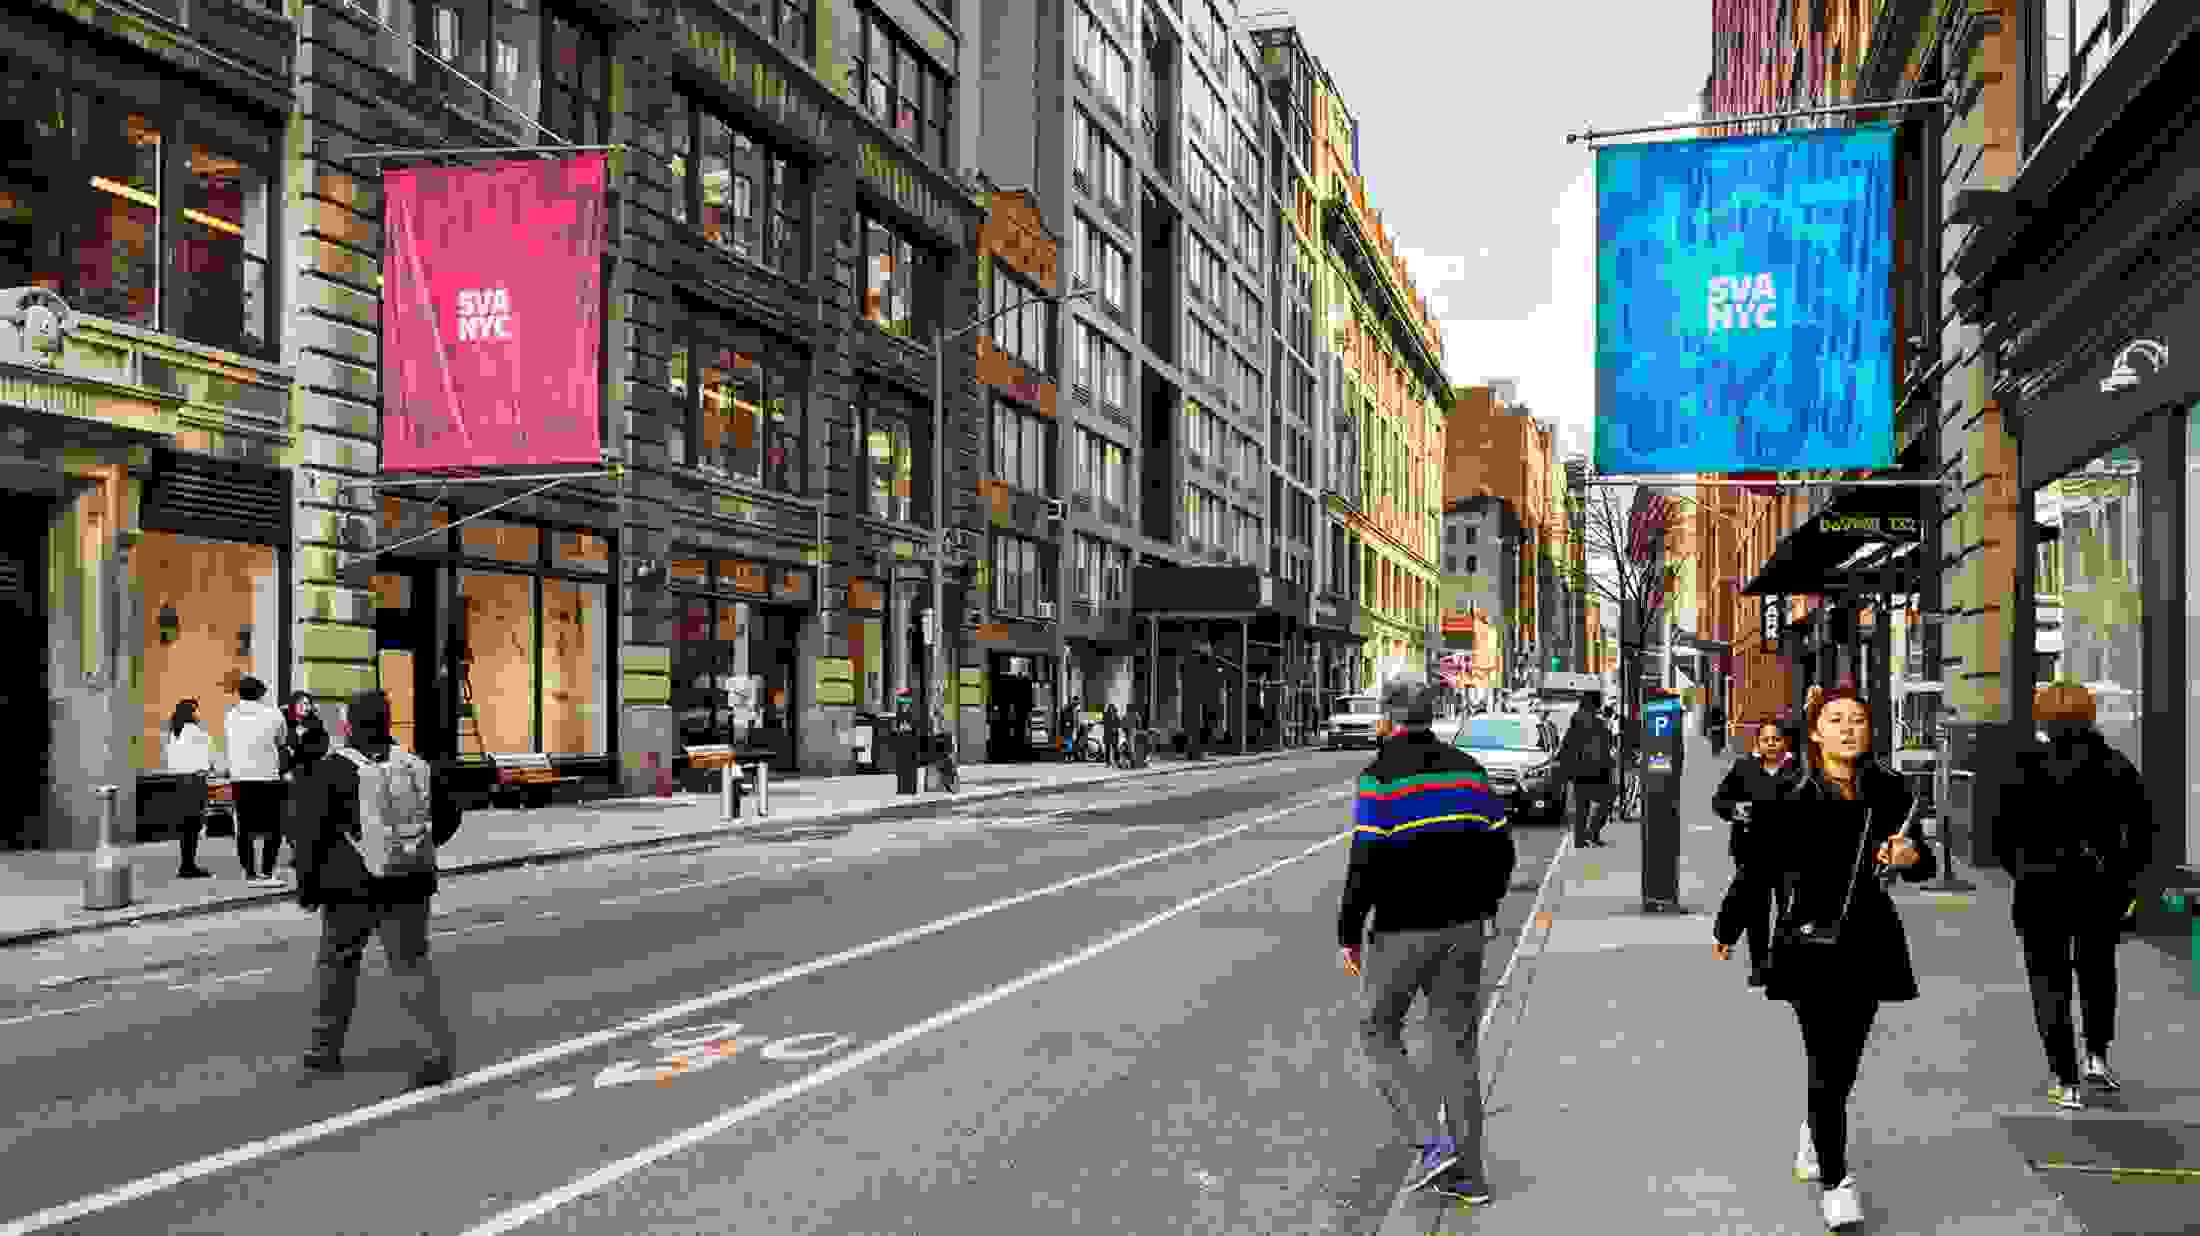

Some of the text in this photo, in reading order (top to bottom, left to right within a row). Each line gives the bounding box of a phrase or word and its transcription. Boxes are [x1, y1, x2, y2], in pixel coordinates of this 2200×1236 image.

[458, 288, 510, 315] SVA
[1707, 273, 1776, 303] SVA
[459, 316, 512, 342] NYC
[1707, 303, 1776, 332] NYC
[1655, 716, 1669, 735] P
